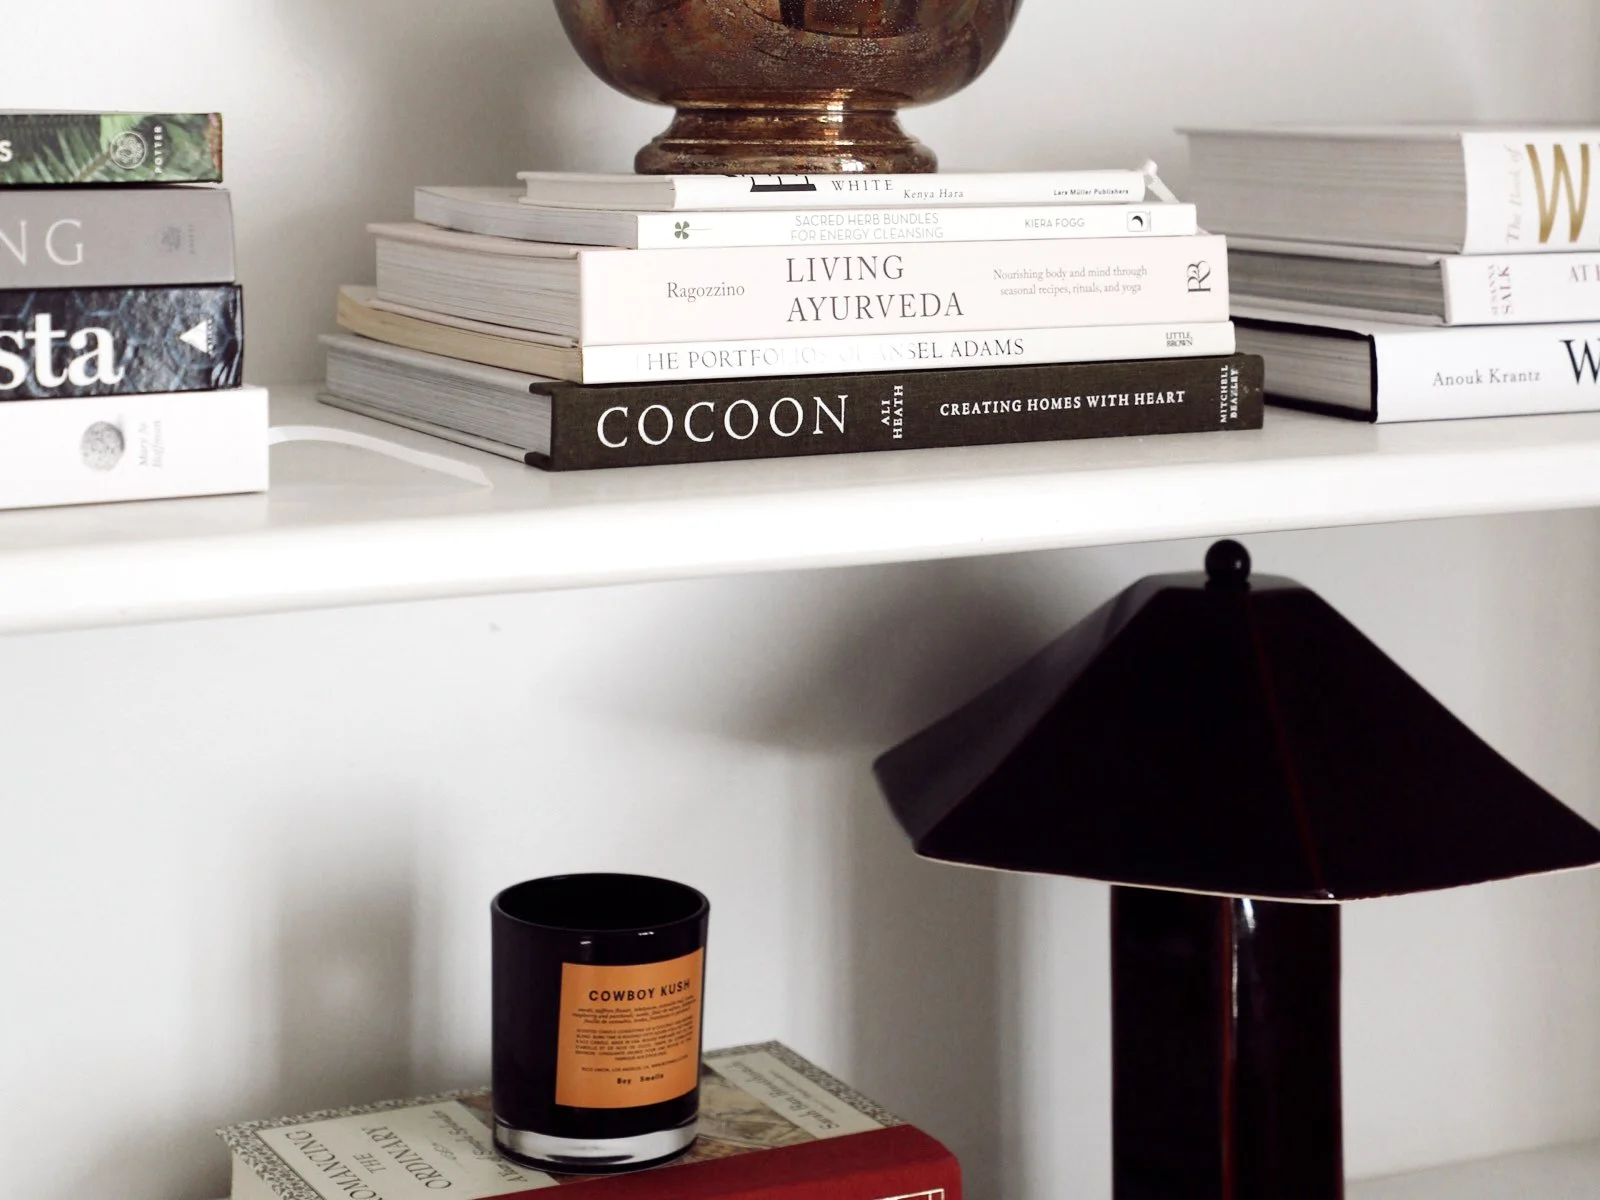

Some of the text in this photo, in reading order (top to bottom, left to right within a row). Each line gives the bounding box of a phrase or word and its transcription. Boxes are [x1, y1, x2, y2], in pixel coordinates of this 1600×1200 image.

[154, 125, 163, 174] POTTER
[831, 179, 894, 192] WHITE
[903, 188, 964, 201] Kenya Hara
[1069, 188, 1092, 196] Müller
[1093, 187, 1130, 196] Publishers
[795, 212, 939, 227] SACRED HERB BUNDLES
[1024, 217, 1085, 228] KIERA FOGG
[790, 227, 944, 242] FOR ENERGY CLEANSING
[786, 255, 904, 283] LIVING
[993, 265, 1148, 282] Nourishing body and mind through
[1567, 264, 1590, 283] AT
[667, 281, 745, 303] Ragozzino
[1000, 282, 1142, 297] seasonal recipes, rituals, and yoga
[786, 292, 965, 323] AYURVEDA
[1166, 339, 1193, 348] BROWN
[637, 351, 679, 373] HE
[950, 338, 1024, 358] ADAMS
[1432, 368, 1541, 387] Anouk Krantz
[881, 398, 890, 426] ALI
[892, 384, 904, 439] HEATH
[940, 390, 1186, 417] CREATING HOMES WITH HEART
[597, 395, 849, 448] COCOON
[588, 979, 691, 1002] COWBOY KUSH
[285, 1129, 383, 1200] OMANCING
[353, 1152, 387, 1174] THE
[362, 1126, 451, 1190] ORDINARY
